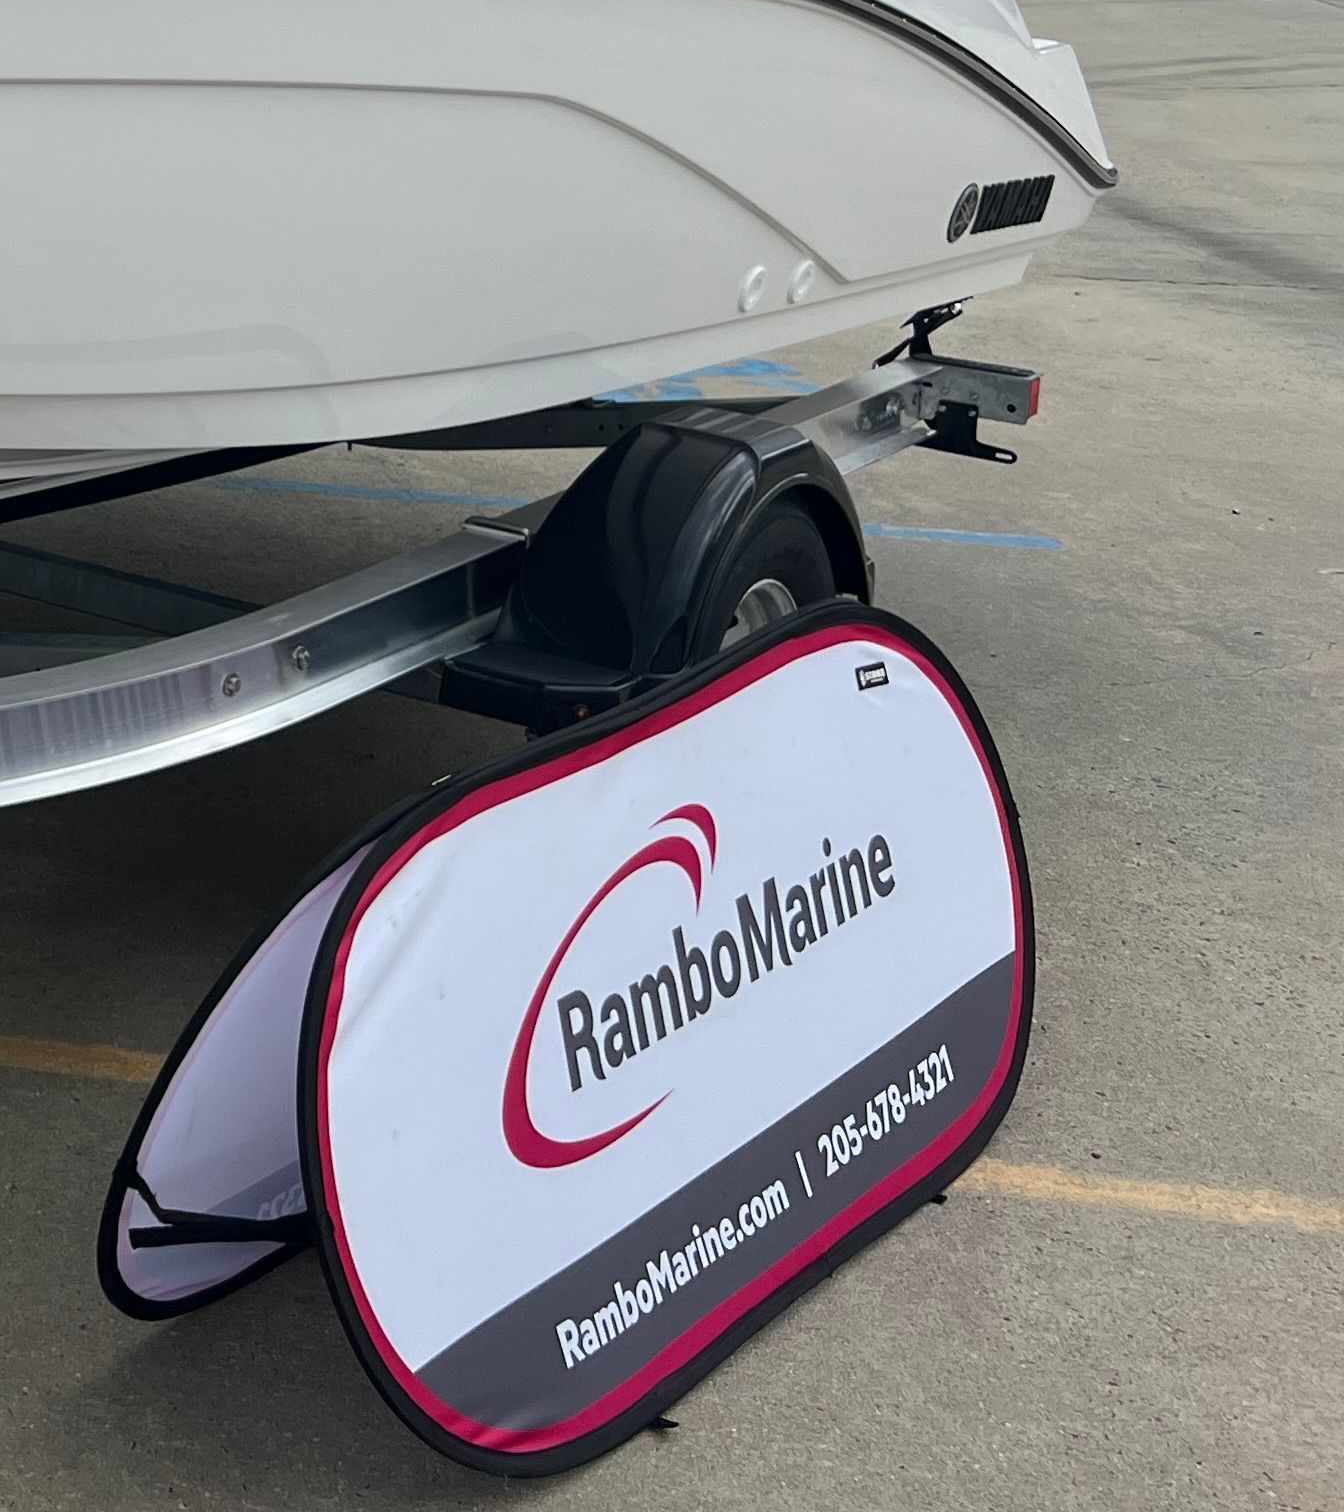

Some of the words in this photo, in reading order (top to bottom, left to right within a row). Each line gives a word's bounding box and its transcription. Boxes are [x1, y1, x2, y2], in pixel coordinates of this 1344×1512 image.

[970, 174, 1055, 235] YAMAHA
[557, 834, 895, 1093] RamboMarine
[555, 1178, 790, 1369] RamboMarine.com
[817, 1044, 955, 1177] 205-678-4321
